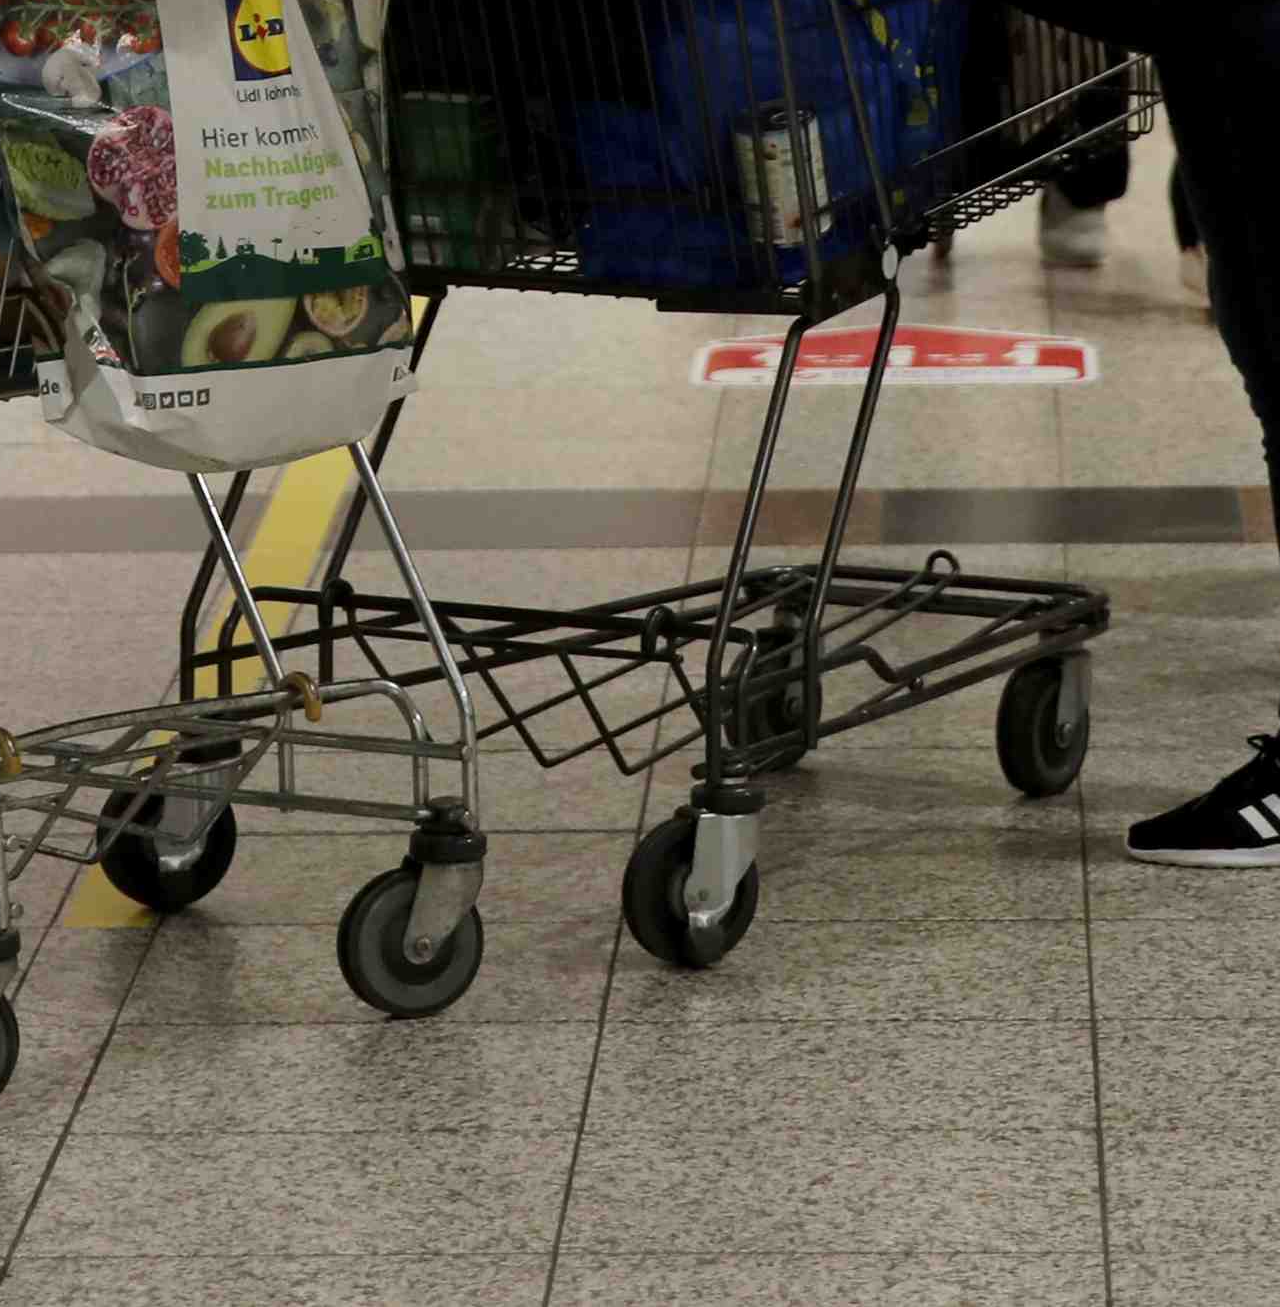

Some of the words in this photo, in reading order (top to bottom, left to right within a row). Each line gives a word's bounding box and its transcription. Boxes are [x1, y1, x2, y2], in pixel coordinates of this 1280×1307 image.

[202, 127, 248, 148] Hier
[205, 149, 344, 178] Nachhaltig
[206, 192, 257, 209] zum
